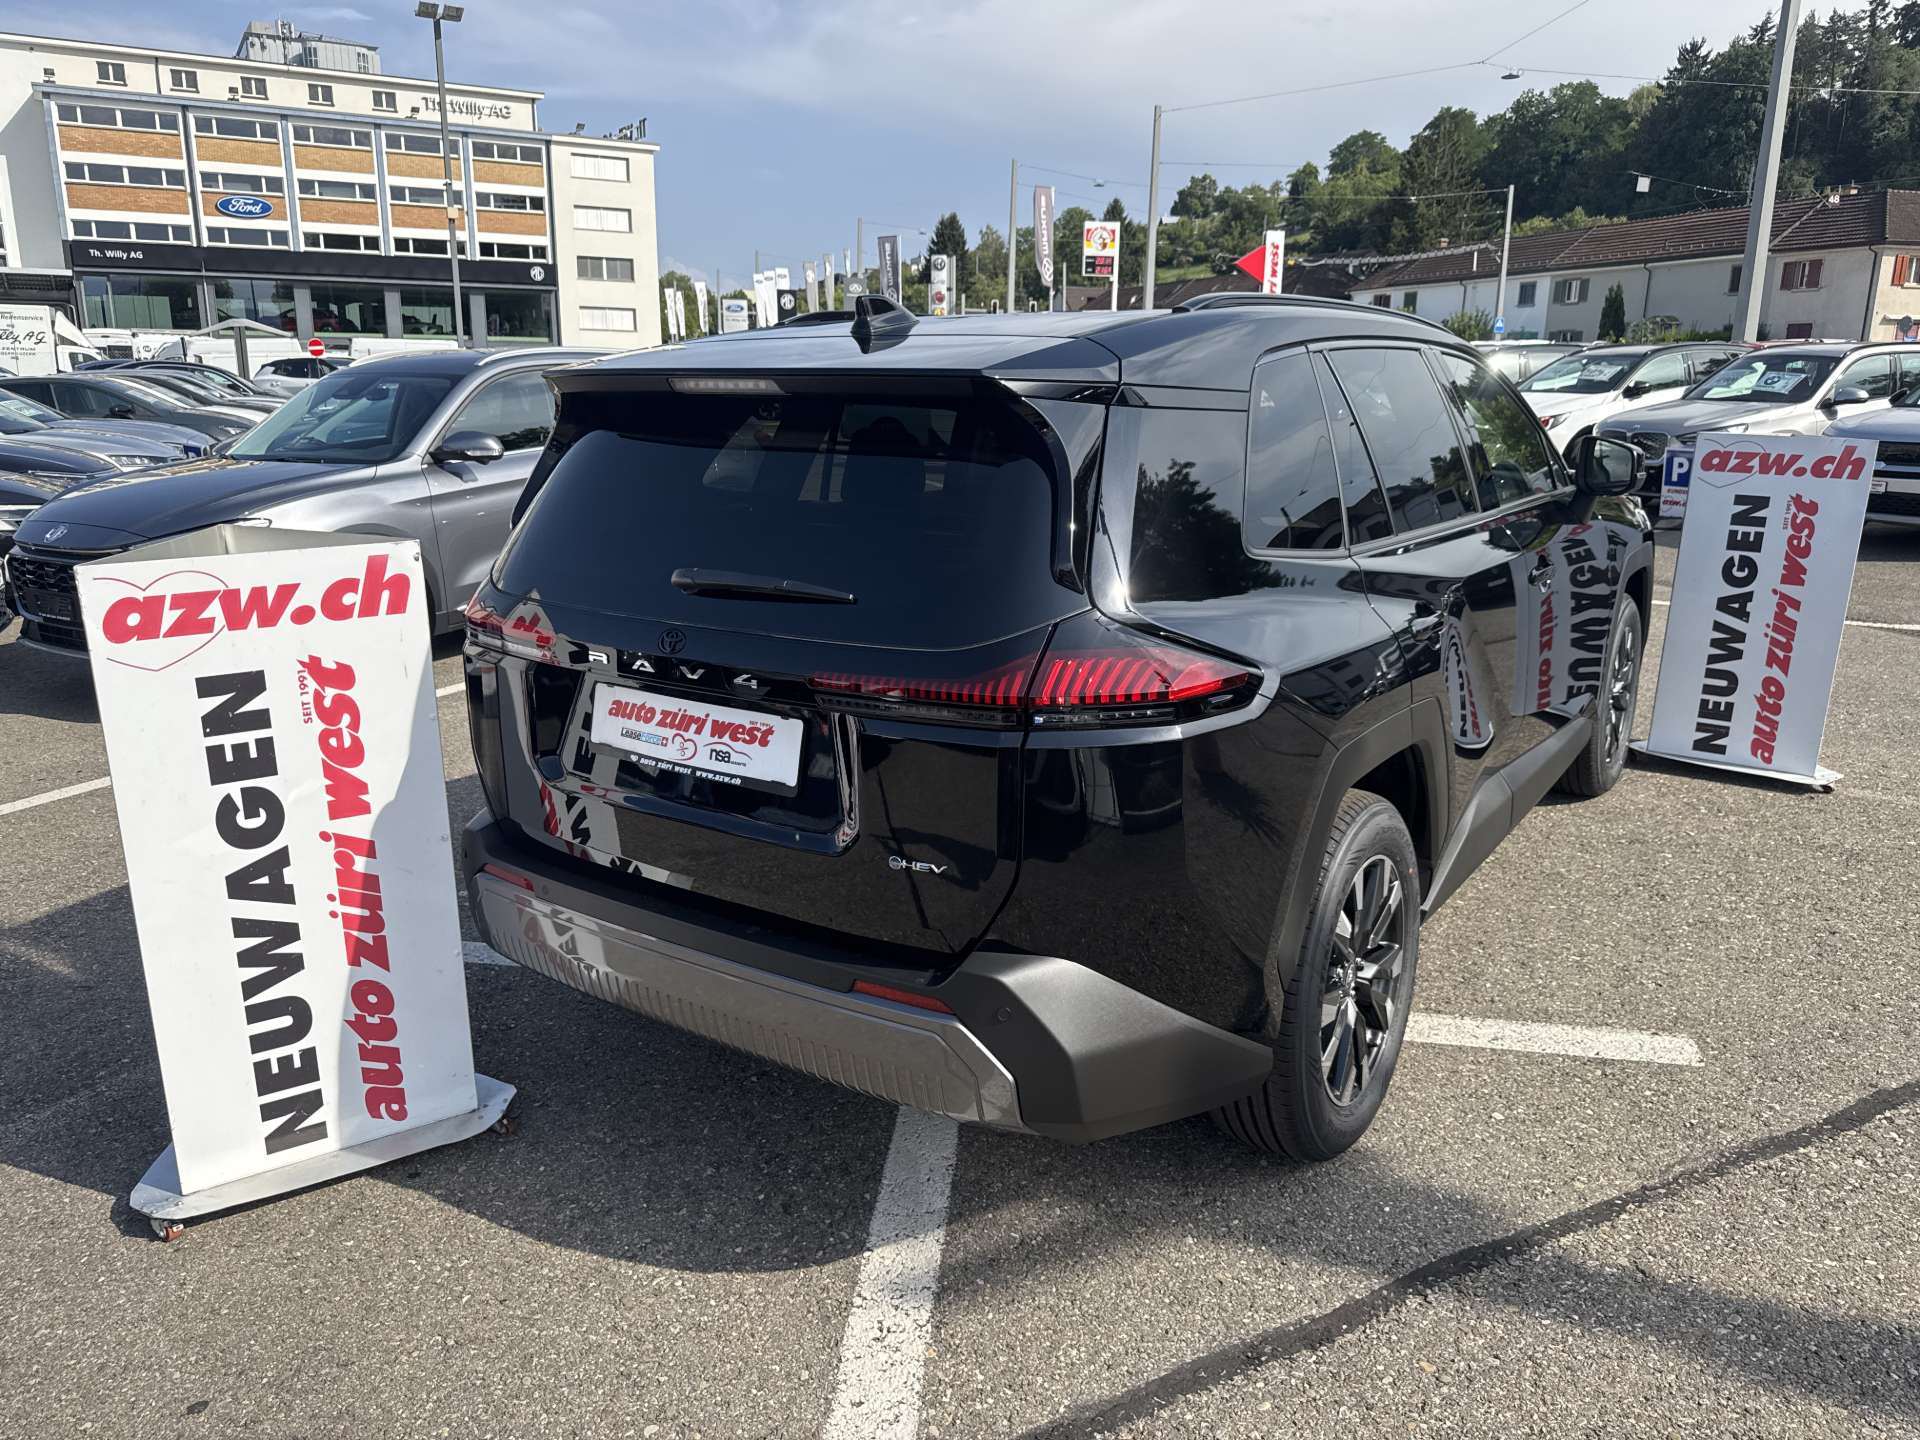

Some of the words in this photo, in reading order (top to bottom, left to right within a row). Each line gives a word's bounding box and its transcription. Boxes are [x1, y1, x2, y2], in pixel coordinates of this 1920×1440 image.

[448, 99, 484, 120] Willy
[488, 103, 512, 119] AG
[228, 198, 263, 214] Ford
[1828, 194, 1840, 203] 48
[88, 249, 103, 257] Th.
[104, 250, 127, 260] Willy
[129, 251, 143, 259] AG
[23, 331, 47, 345] AG
[1671, 456, 1689, 482] P
[1700, 446, 1866, 481] azw.ch
[1780, 492, 1819, 587] west
[101, 554, 411, 645] azw.ch
[1692, 493, 1771, 756] NEUWAGEN
[1763, 587, 1802, 678] züri
[297, 669, 310, 697] 1991
[301, 701, 313, 724] SEIT
[608, 699, 657, 724] auto
[655, 707, 710, 736] züri
[710, 718, 775, 747] west
[1751, 676, 1785, 766] auto
[296, 654, 372, 821] west
[674, 765, 692, 775] west
[709, 748, 731, 764] nsa
[902, 859, 948, 874] HEV
[195, 669, 328, 1156] NEUWAGEN
[327, 831, 390, 971] züri
[344, 978, 408, 1122] auto
